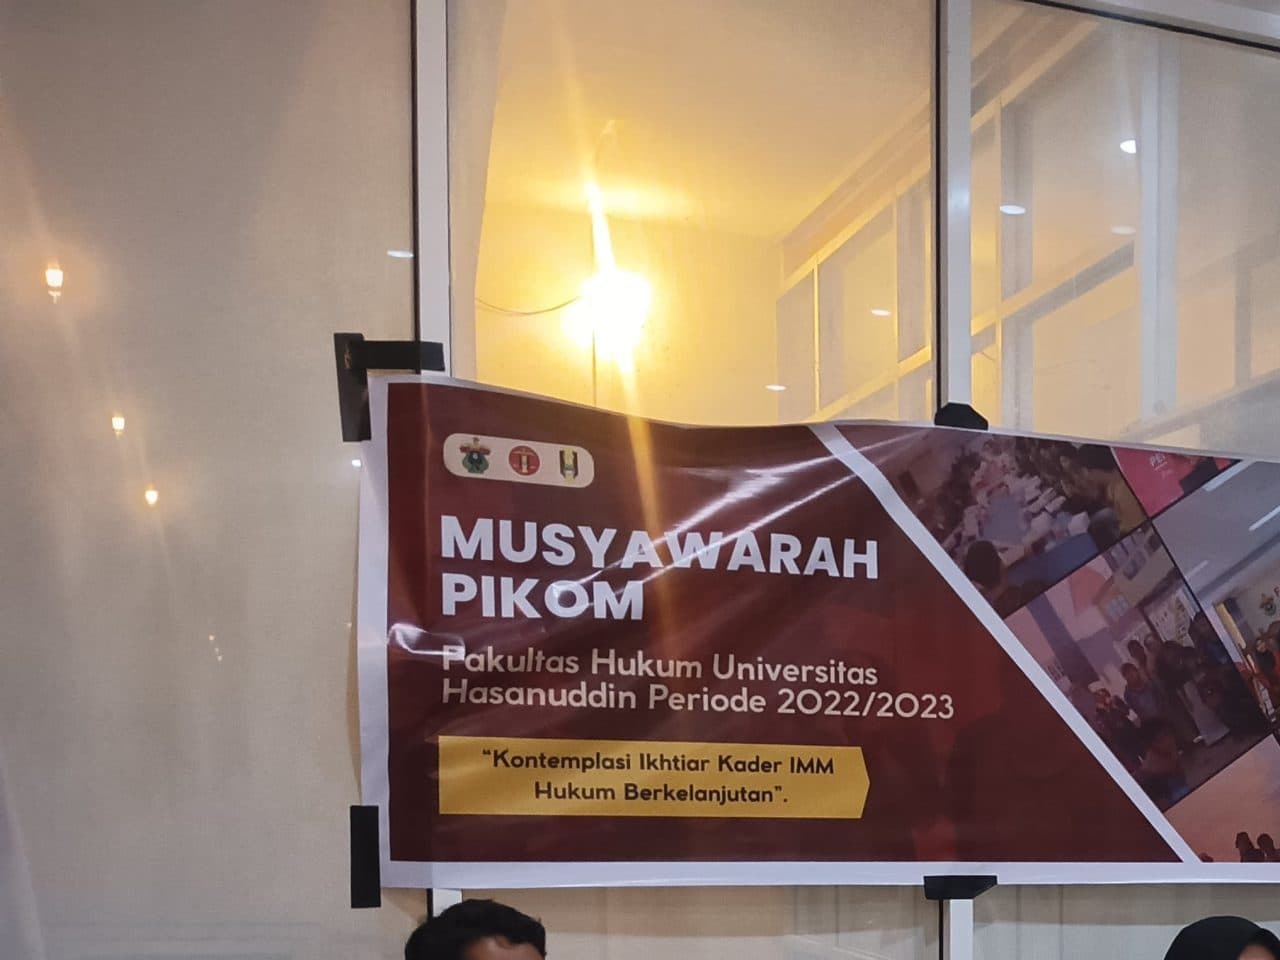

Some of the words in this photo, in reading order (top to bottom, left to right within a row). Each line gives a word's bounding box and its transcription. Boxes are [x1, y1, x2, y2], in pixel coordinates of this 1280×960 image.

[441, 515, 878, 579] MUSYAWARAH
[442, 572, 644, 620] PIKOM
[442, 645, 580, 673] Fakultas
[591, 648, 702, 678] Hukum
[712, 653, 878, 686] Universitas
[442, 677, 637, 710] Hasanuddin
[649, 683, 767, 713] Periode
[777, 687, 955, 719] 2022/2023
[639, 753, 710, 772] Ikhtiar
[718, 755, 783, 774] Kader
[790, 757, 835, 775] IMM
[534, 781, 616, 800] Hukum
